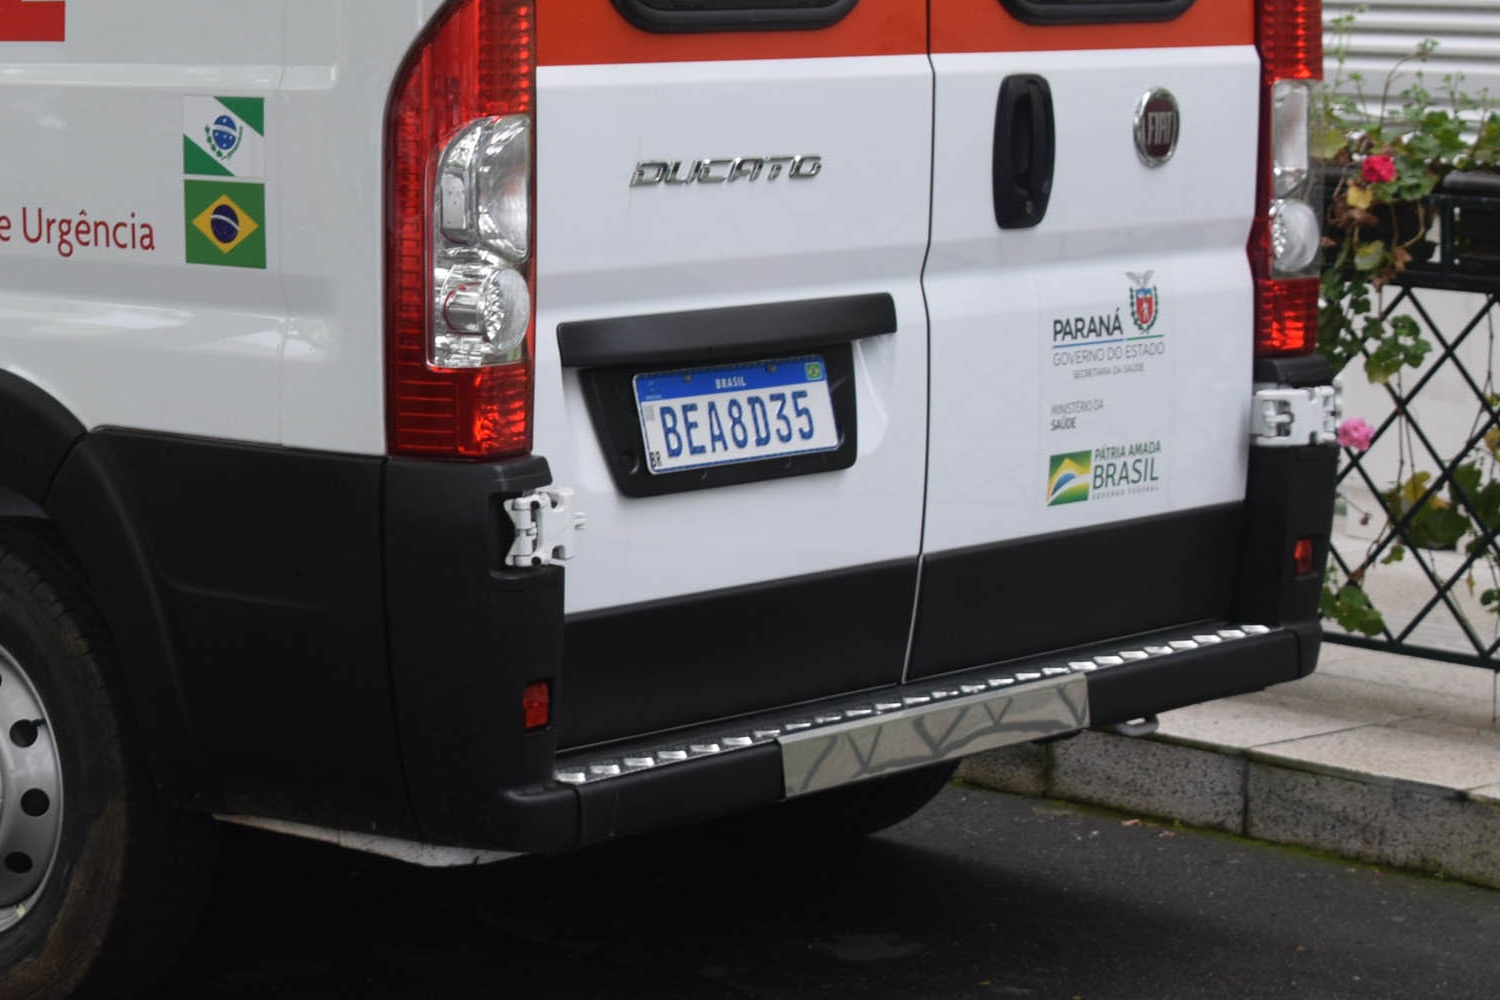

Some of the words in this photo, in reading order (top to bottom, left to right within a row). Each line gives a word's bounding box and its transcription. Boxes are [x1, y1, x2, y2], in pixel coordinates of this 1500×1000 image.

[629, 156, 821, 187] DUCATO
[22, 206, 155, 257] Urgência
[1053, 307, 1123, 341] PARANÁ
[1053, 348, 1105, 367] GOVERNO
[1107, 346, 1122, 361] DO
[1125, 341, 1164, 359] ESTADO
[715, 375, 747, 389] BRASIL
[659, 390, 815, 458] BEA8D35
[1094, 444, 1126, 462] PÁTRIA
[1128, 440, 1161, 457] AMADA
[1092, 458, 1159, 490] BRASIL
